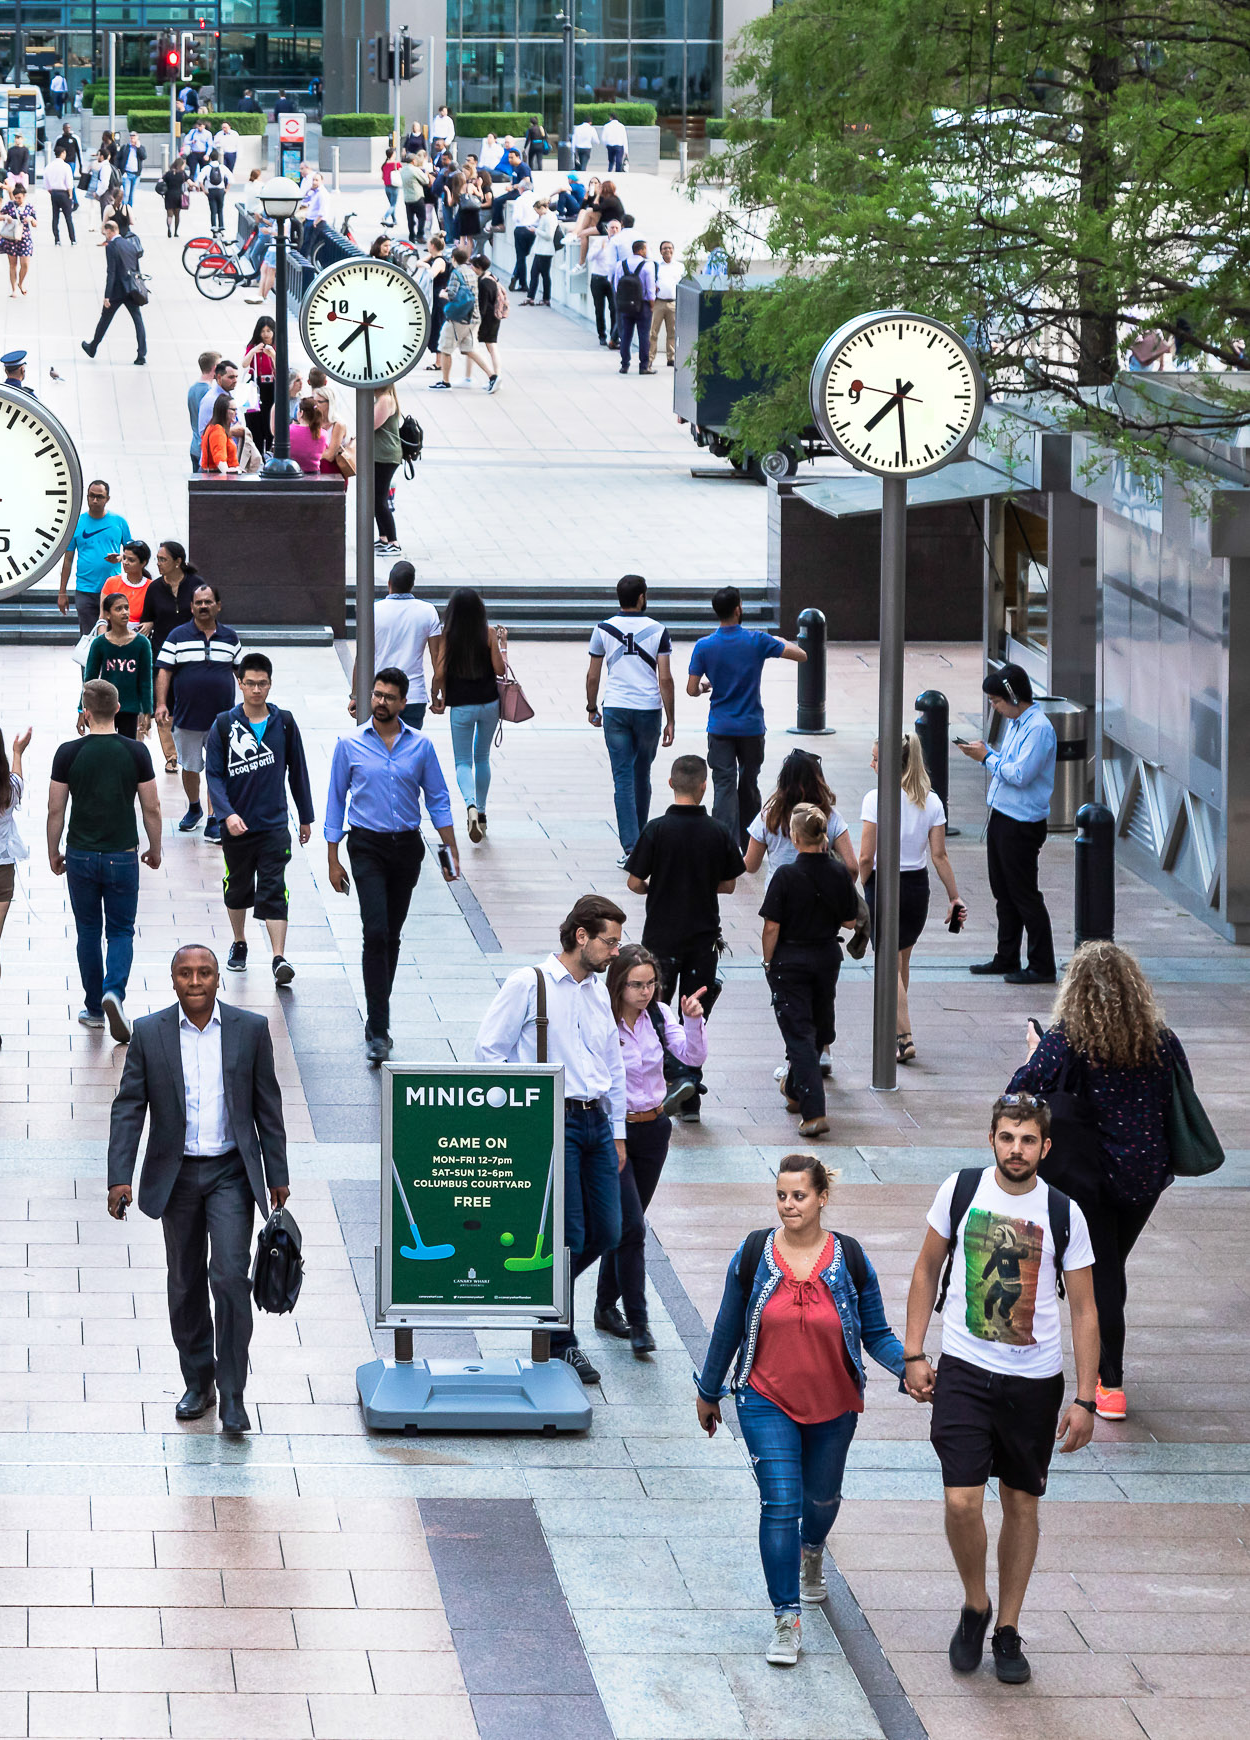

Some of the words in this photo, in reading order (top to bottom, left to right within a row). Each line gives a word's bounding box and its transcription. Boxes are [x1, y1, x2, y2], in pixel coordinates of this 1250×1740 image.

[330, 300, 349, 314] 10
[848, 385, 861, 405] 9
[623, 632, 639, 656] 1
[106, 658, 136, 673] NYC
[235, 764, 250, 774] coq
[406, 1086, 541, 1108] MINIGOLF
[438, 1136, 481, 1149] GAME
[485, 1137, 507, 1149] ON
[432, 1155, 476, 1164] MON-FRI
[478, 1156, 513, 1166] 12-7pm
[431, 1168, 475, 1177] SAT-SUN
[477, 1169, 514, 1178] 12-6pm
[413, 1179, 469, 1188] COLUMBUS
[470, 1180, 532, 1189] COURTYARD
[454, 1196, 492, 1208] FREE
